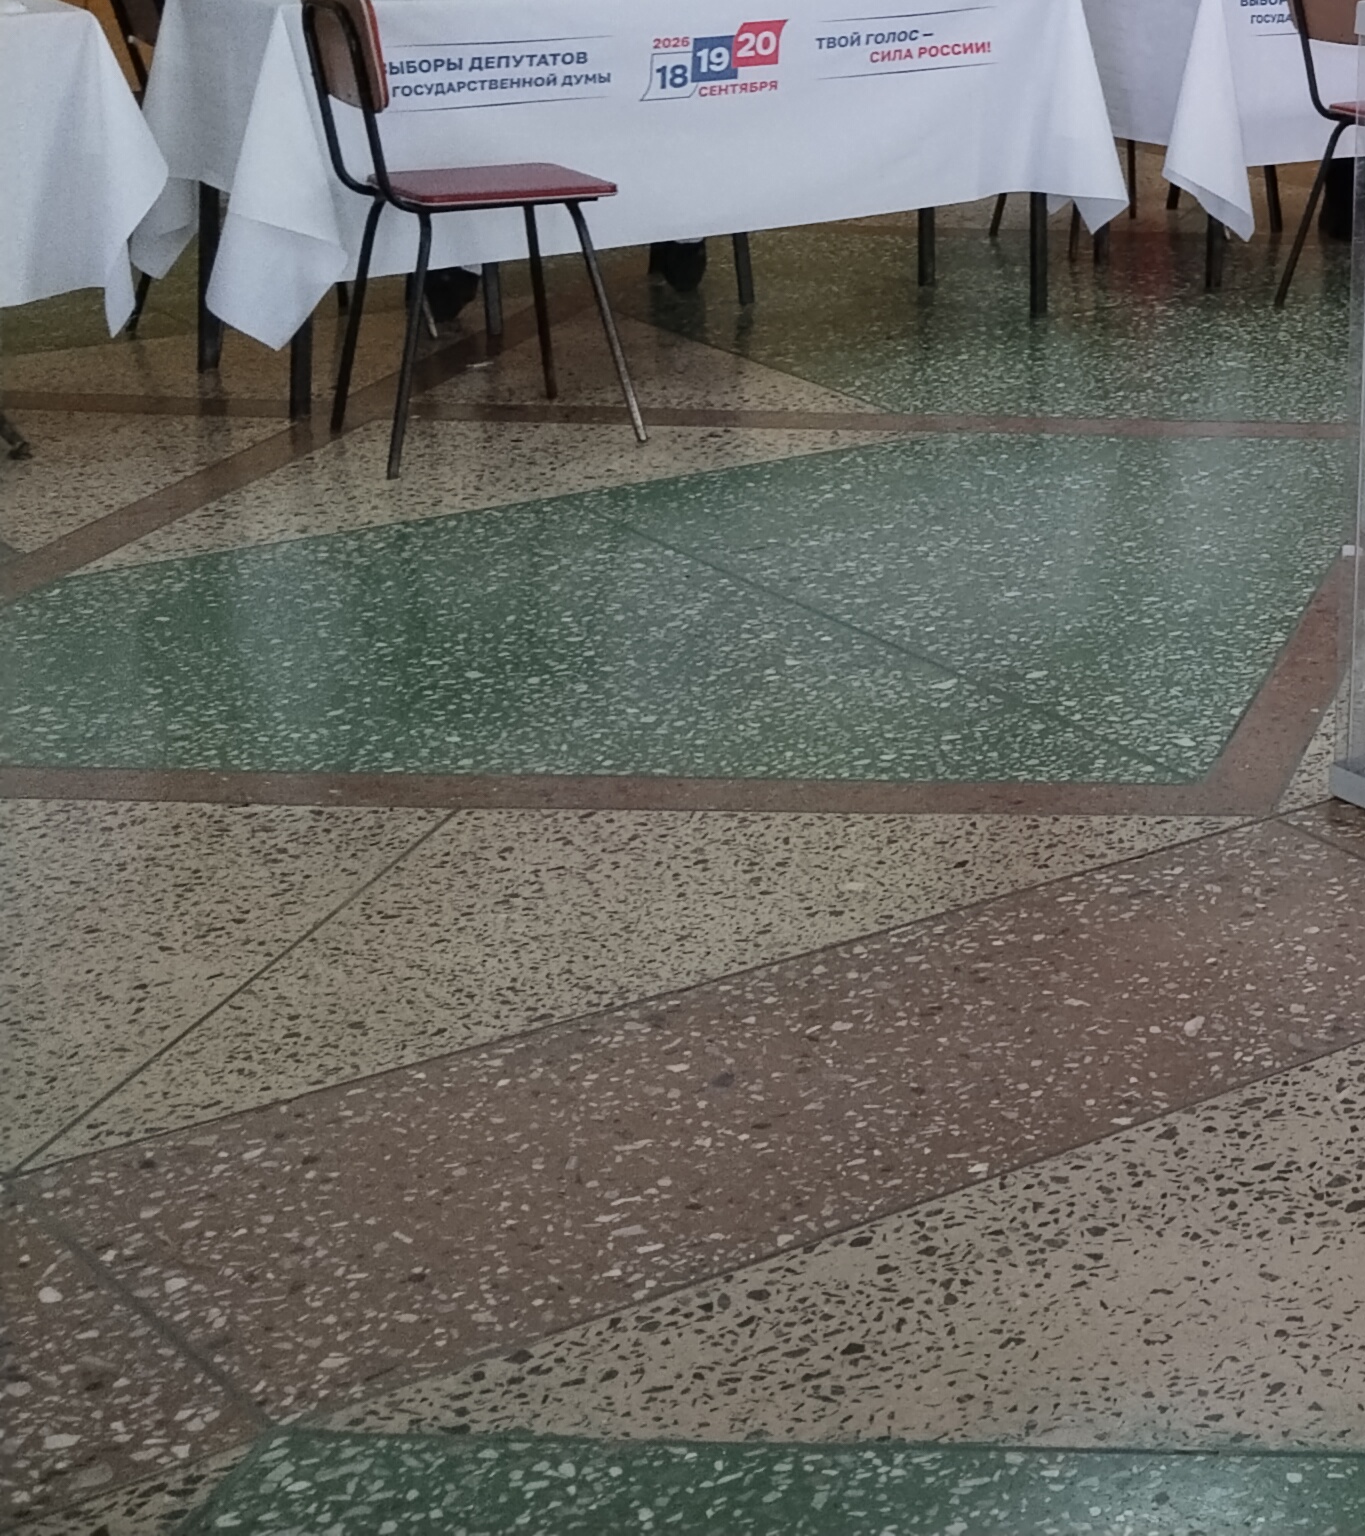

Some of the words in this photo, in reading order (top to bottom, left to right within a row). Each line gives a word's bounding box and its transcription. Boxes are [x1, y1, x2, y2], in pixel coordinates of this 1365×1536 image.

[652, 36, 691, 50] 2026
[815, 31, 862, 50] ТВОЙ
[865, 29, 920, 46] ГОЛОС
[384, 57, 463, 76] ЫБОРЫ
[469, 51, 588, 72] ДЕПУТАТОВ
[655, 63, 689, 90] 18
[696, 46, 730, 73] 19
[737, 30, 777, 57] 20
[869, 48, 913, 64] СИЛА
[917, 41, 992, 61] РОССИИ!
[391, 72, 557, 98] ГОСУДАРСТВЕННОЙ
[560, 72, 612, 88] ДУМЫ
[698, 80, 778, 98] СЕНТЯБРЯ
